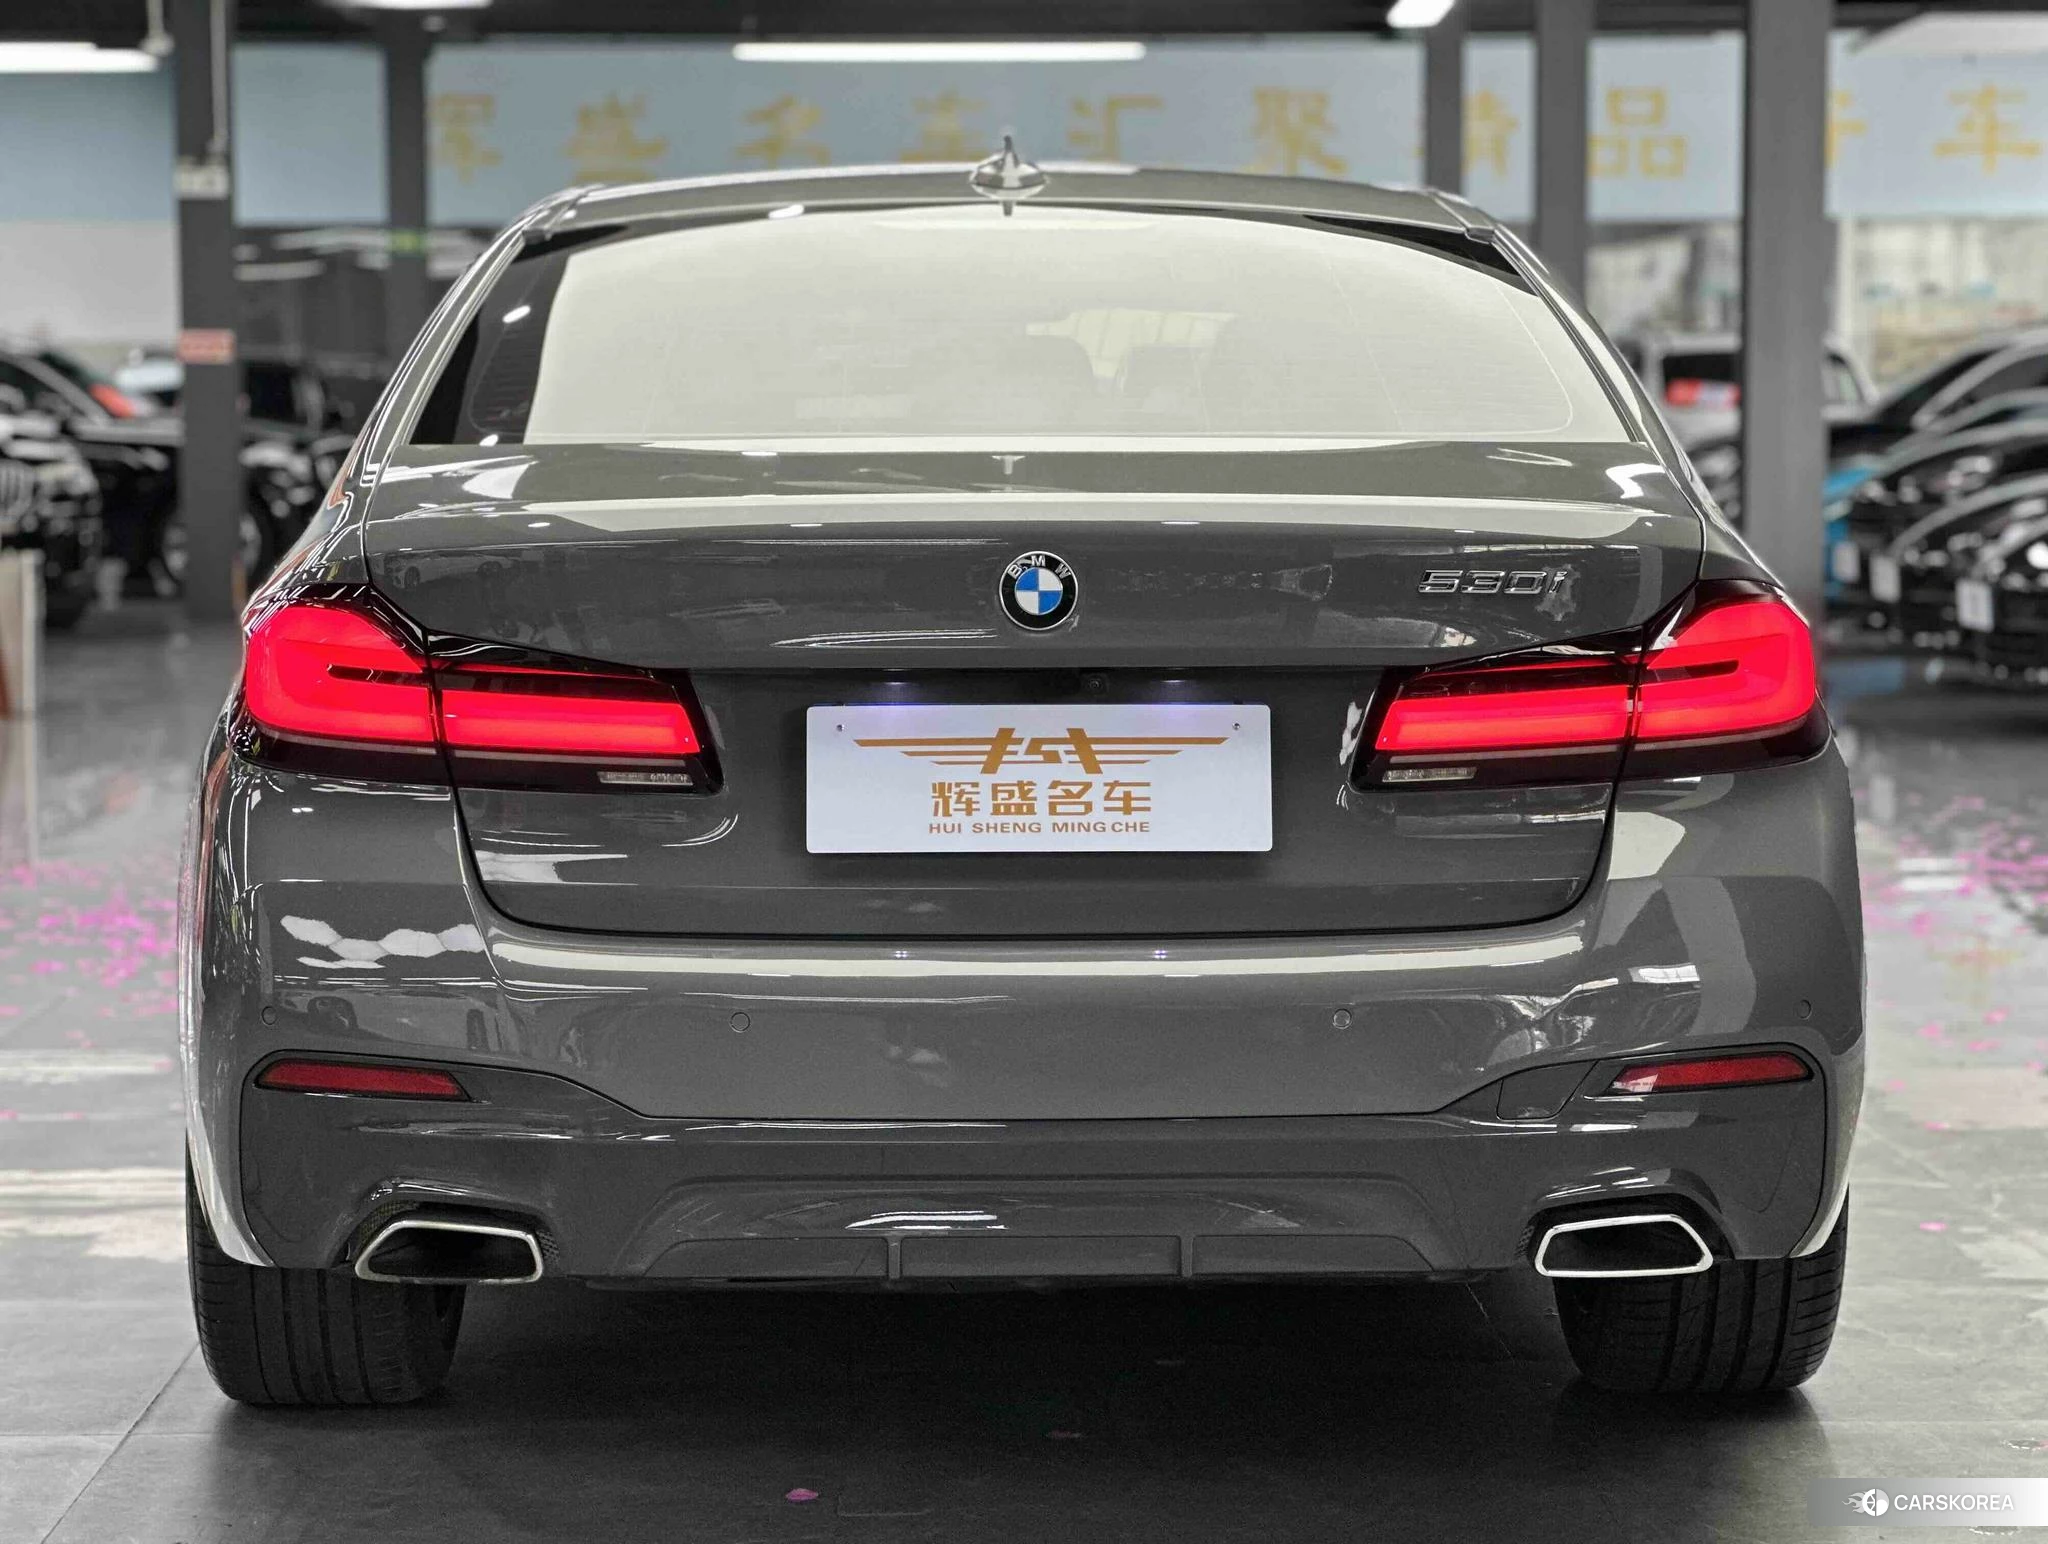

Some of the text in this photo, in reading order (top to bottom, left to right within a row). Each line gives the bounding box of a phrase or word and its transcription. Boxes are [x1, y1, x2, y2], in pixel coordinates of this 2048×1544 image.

[1008, 554, 1072, 580] BMW
[1418, 569, 1568, 594] 530i
[931, 780, 1151, 817] 辉盛名车
[928, 820, 1150, 834] HUI SHENG MING CHE
